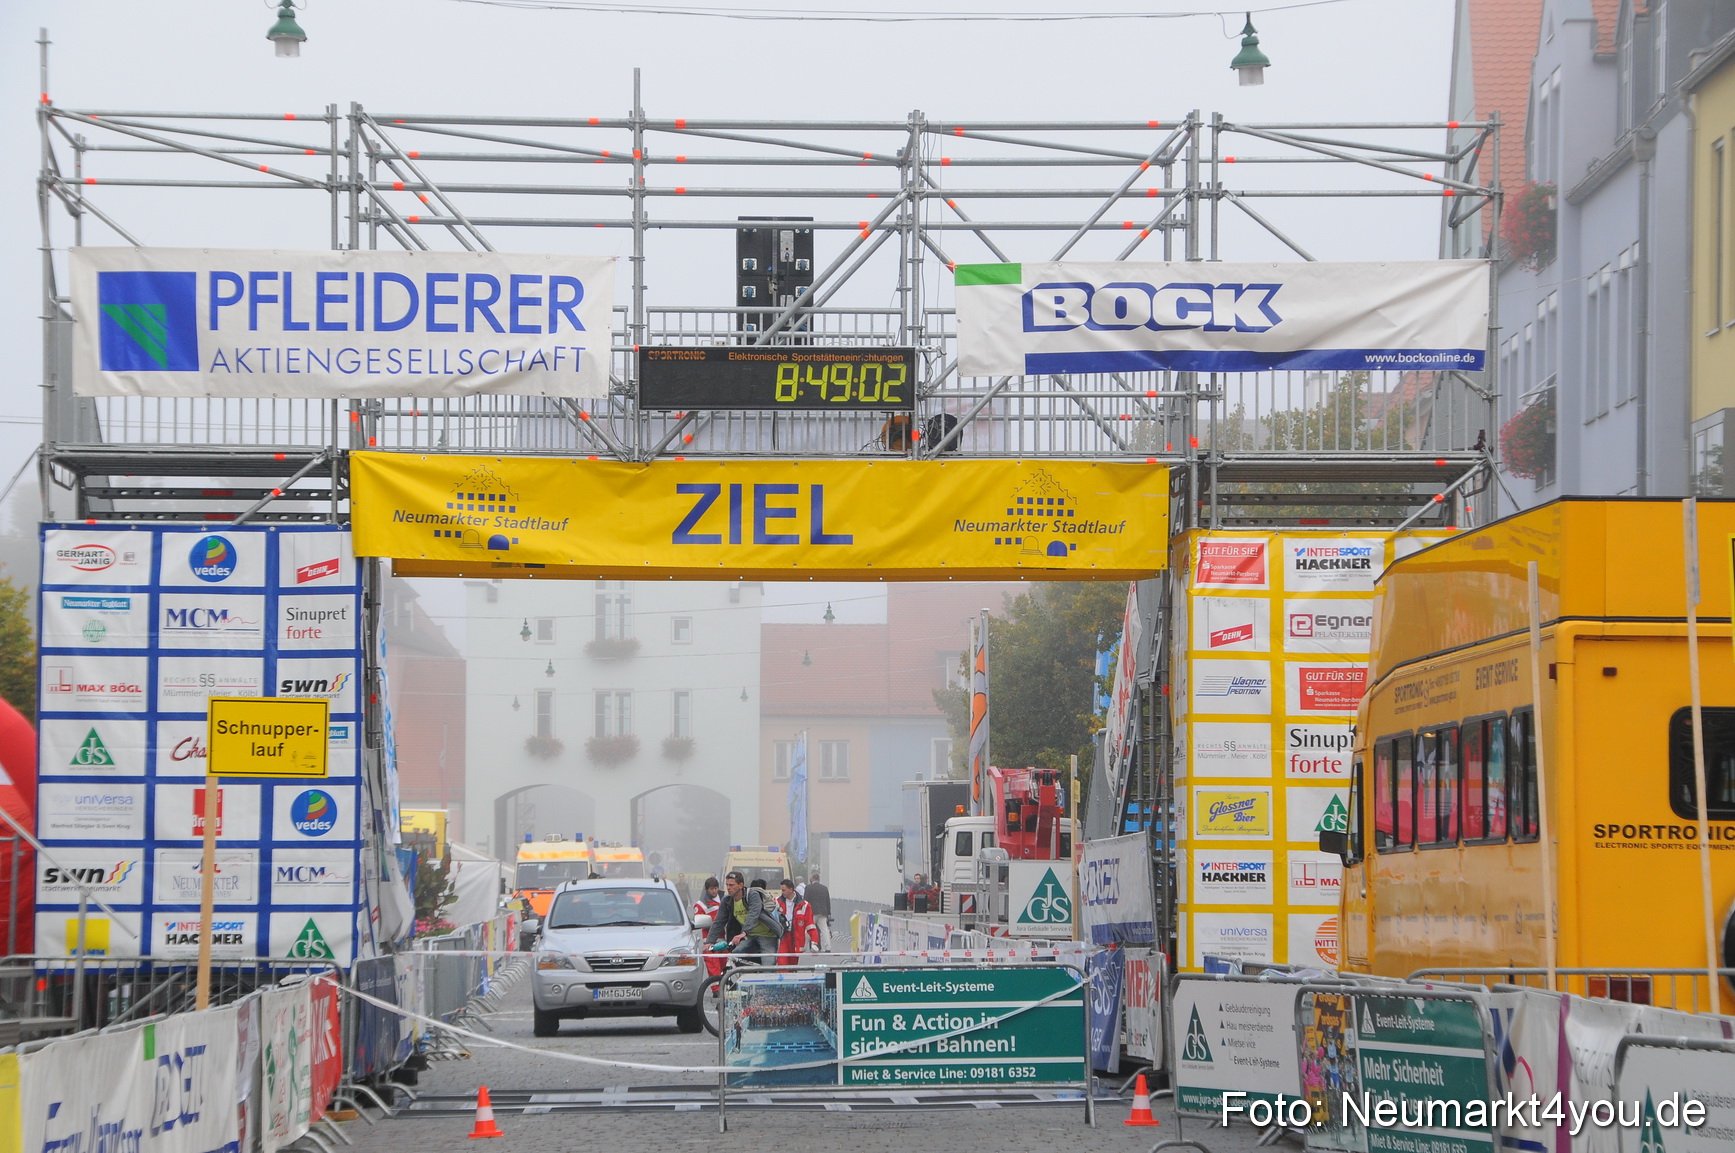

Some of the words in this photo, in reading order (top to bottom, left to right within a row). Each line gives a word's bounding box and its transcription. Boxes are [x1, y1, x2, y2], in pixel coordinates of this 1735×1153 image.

[209, 270, 587, 334] PFLEIDERER
[1022, 282, 1284, 333] BOCK
[209, 346, 587, 375] AKTIENGESELLSCHAFT
[728, 352, 788, 362] Elektronische
[1364, 352, 1476, 366] www.bockonline.de
[775, 363, 907, 402] 8:49:02
[392, 509, 490, 527] Neumarkter
[493, 515, 569, 531] Stadtlauf
[672, 483, 854, 545] ZIEL
[953, 518, 1048, 533] Neumarkter
[1052, 519, 1126, 535] Stadtlauf
[56, 550, 104, 558] GERHART
[1202, 546, 1220, 555] GUT
[1221, 545, 1239, 555] FÜR
[1241, 546, 1259, 555] SIE!
[1307, 547, 1372, 557] INTERSPORT
[194, 564, 230, 577] vedes
[307, 565, 329, 577] DEHN
[1295, 558, 1372, 570] HACKNER
[166, 607, 229, 628] MCM
[286, 607, 346, 624] Sinupret
[286, 625, 322, 640] forte
[1221, 630, 1243, 642] DEHN
[218, 676, 258, 684] ANWÄLTE
[1231, 676, 1266, 687] Wagner
[1305, 672, 1325, 681] GUT
[1326, 671, 1344, 681] FÜR
[1346, 672, 1364, 681] SIE!
[1475, 664, 1494, 691] EVENT
[1495, 658, 1519, 686] SERVICE
[76, 684, 105, 693] MAX
[110, 682, 142, 693] BÖGL
[163, 689, 203, 697] Mümmler
[208, 689, 232, 697] Meier
[238, 689, 258, 697] Kölbl
[280, 679, 329, 693] swn
[216, 720, 319, 739] Schnupper-
[251, 742, 285, 757] lauf
[1289, 753, 1343, 774] forte
[74, 794, 133, 805] uniVersa
[1209, 798, 1257, 822] Glossner
[1233, 811, 1256, 822] Bier
[296, 819, 331, 830] vedes
[1211, 862, 1267, 871] INTERSPORT
[276, 866, 326, 883] MCM
[1202, 872, 1267, 883] HACKNER
[1220, 927, 1268, 937] uniVersa
[882, 981, 996, 995] Event-Leit-Systeme
[851, 1014, 886, 1033] Fun
[892, 1014, 907, 1032] &
[912, 1012, 976, 1032] Action
[1375, 1013, 1436, 1033] Event-Leit-Systeme
[936, 1035, 1017, 1053] Bahnen!
[1233, 1055, 1280, 1069] Event-Leit-Systeme
[851, 1068, 879, 1081] Miet
[881, 1069, 891, 1080] &
[894, 1067, 938, 1080] Service
[940, 1066, 968, 1080] Line:
[970, 1066, 1004, 1079] 09181
[1006, 1066, 1037, 1079] 6352
[1363, 1056, 1391, 1081] Mehr
[1392, 1058, 1445, 1087] Sicherheit
[1370, 1133, 1386, 1149] Miet
[1392, 1136, 1416, 1152] Service
